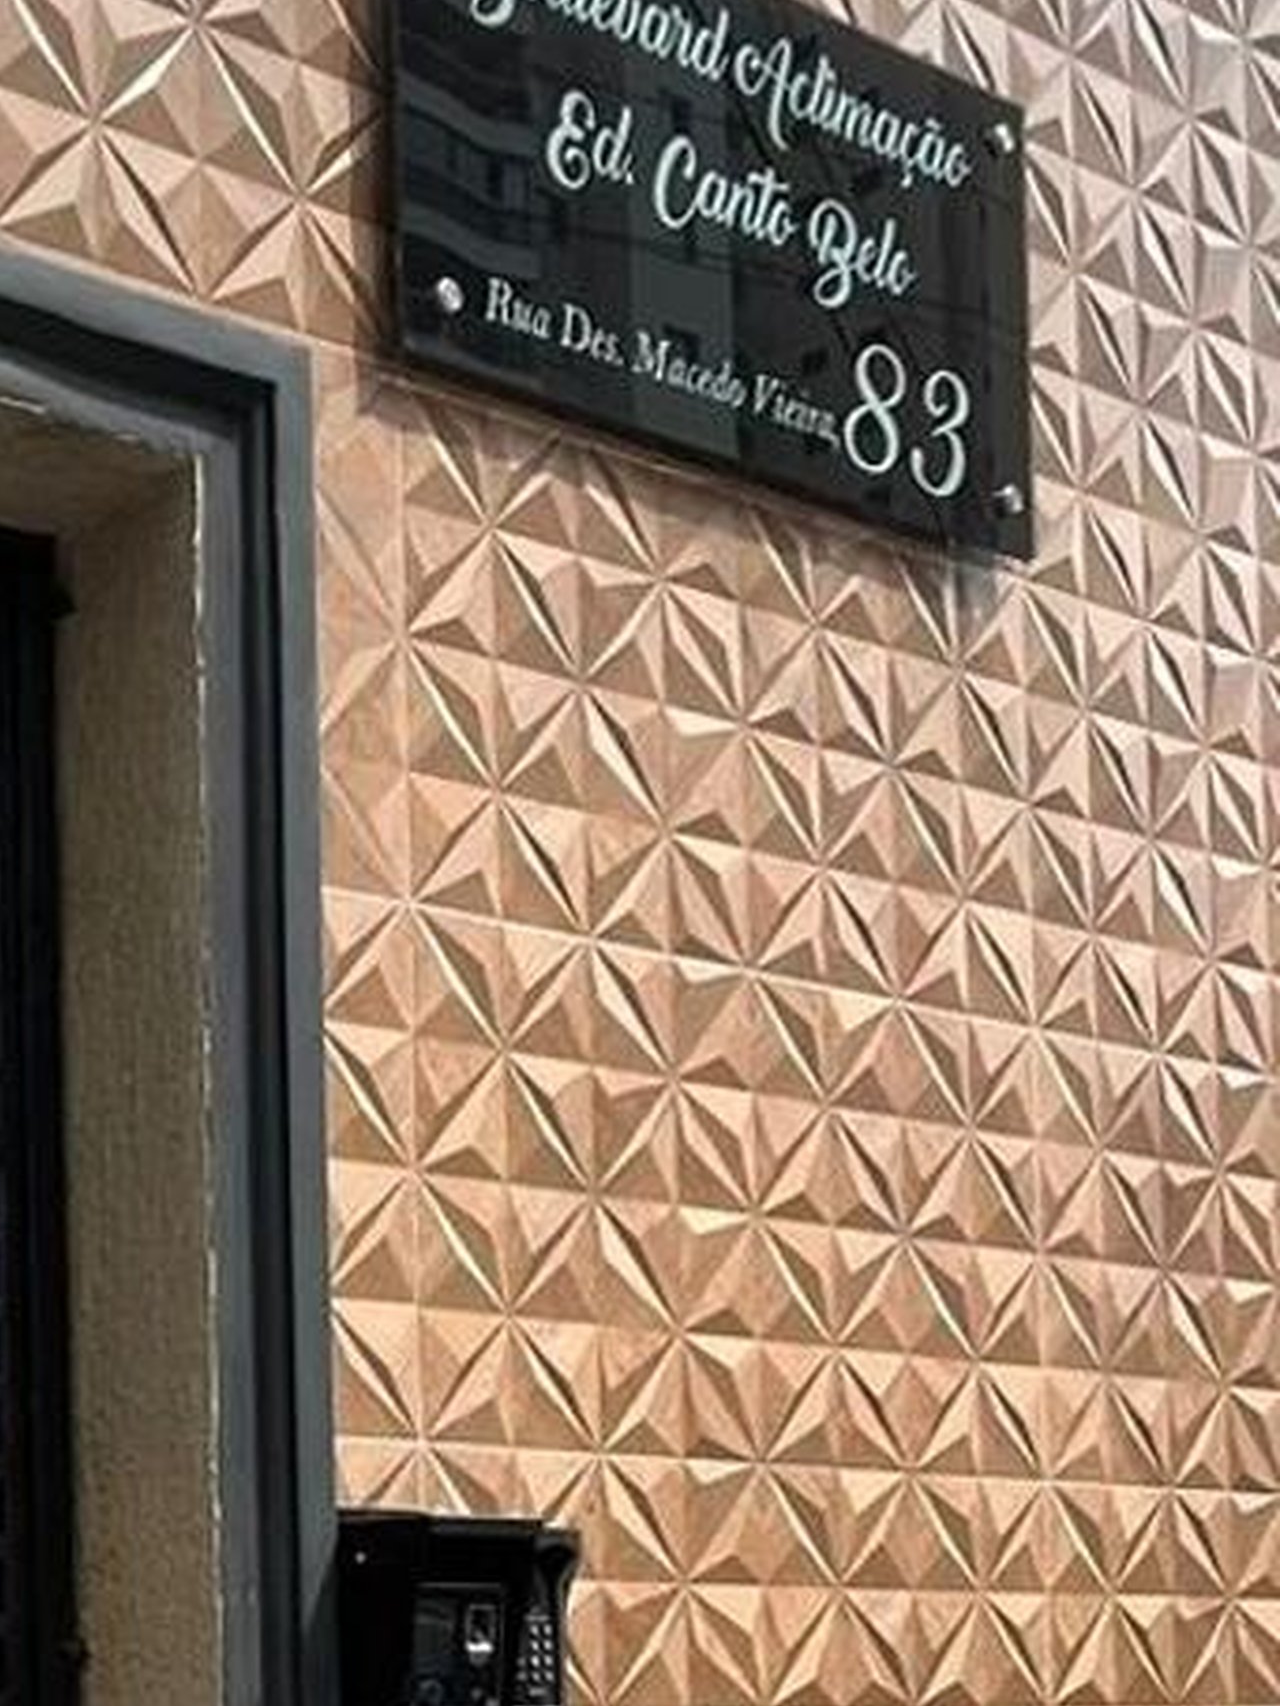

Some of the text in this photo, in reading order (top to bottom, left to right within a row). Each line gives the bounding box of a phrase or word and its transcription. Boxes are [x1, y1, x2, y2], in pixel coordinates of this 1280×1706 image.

[734, 37, 973, 187] Aclimação
[654, 136, 798, 245] Canto
[808, 198, 918, 308] Belo
[485, 277, 552, 340] Rua
[560, 303, 624, 366] Des.
[631, 330, 746, 408] Macedo
[844, 344, 970, 497] 83
